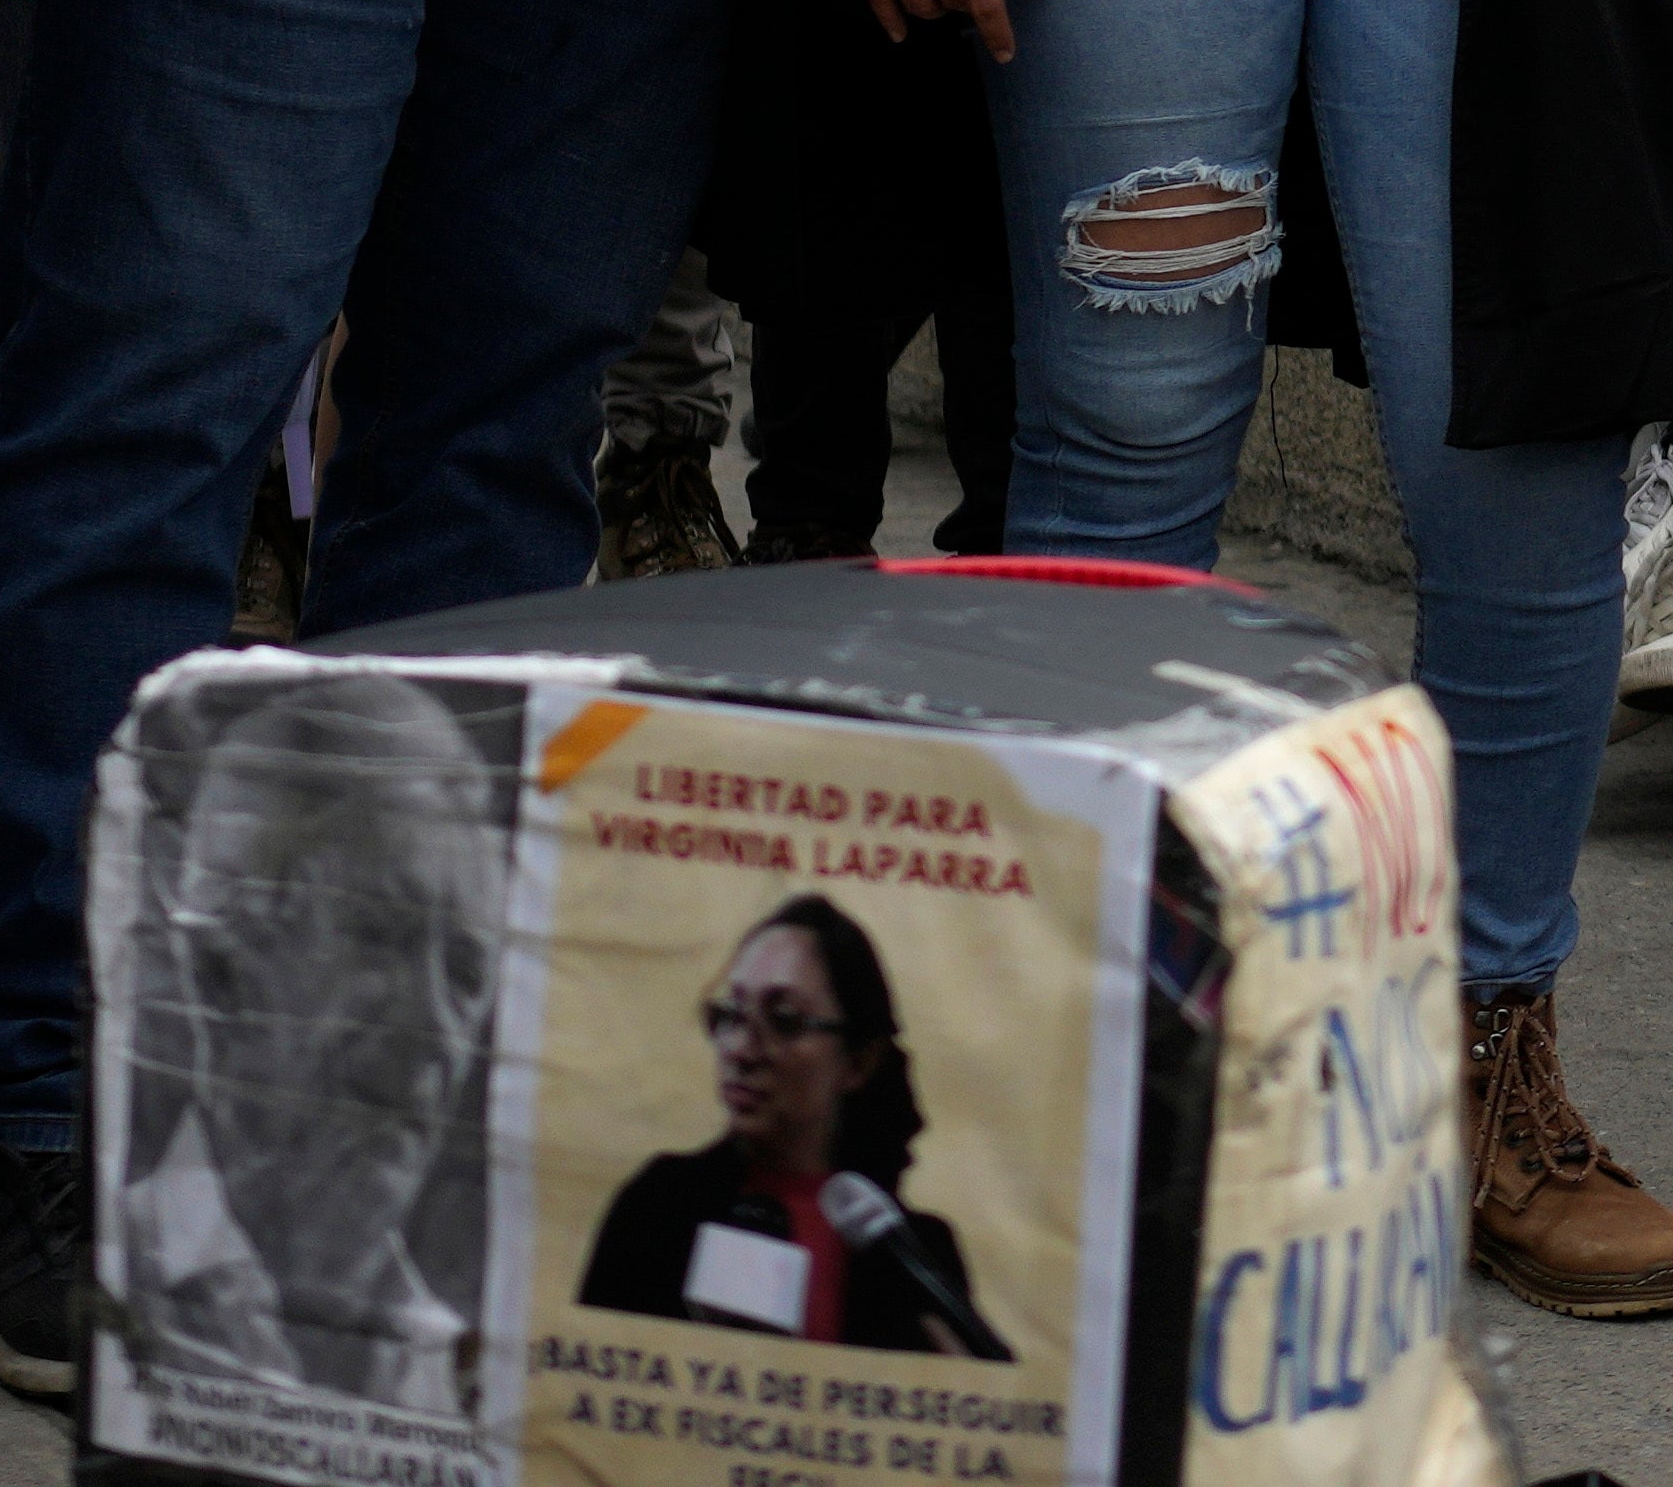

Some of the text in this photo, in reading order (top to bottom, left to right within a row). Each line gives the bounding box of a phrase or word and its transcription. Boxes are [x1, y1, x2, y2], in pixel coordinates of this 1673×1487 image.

[635, 762, 992, 838] LIBERTAD PARA
[591, 810, 1033, 897] VIRGINIA LAPARRA
[569, 1392, 1014, 1481] A EX FISCALES DE LA
[688, 1359, 744, 1399] YA
[758, 1369, 806, 1410] DE
[824, 1379, 1066, 1437] PERSEGUIR
